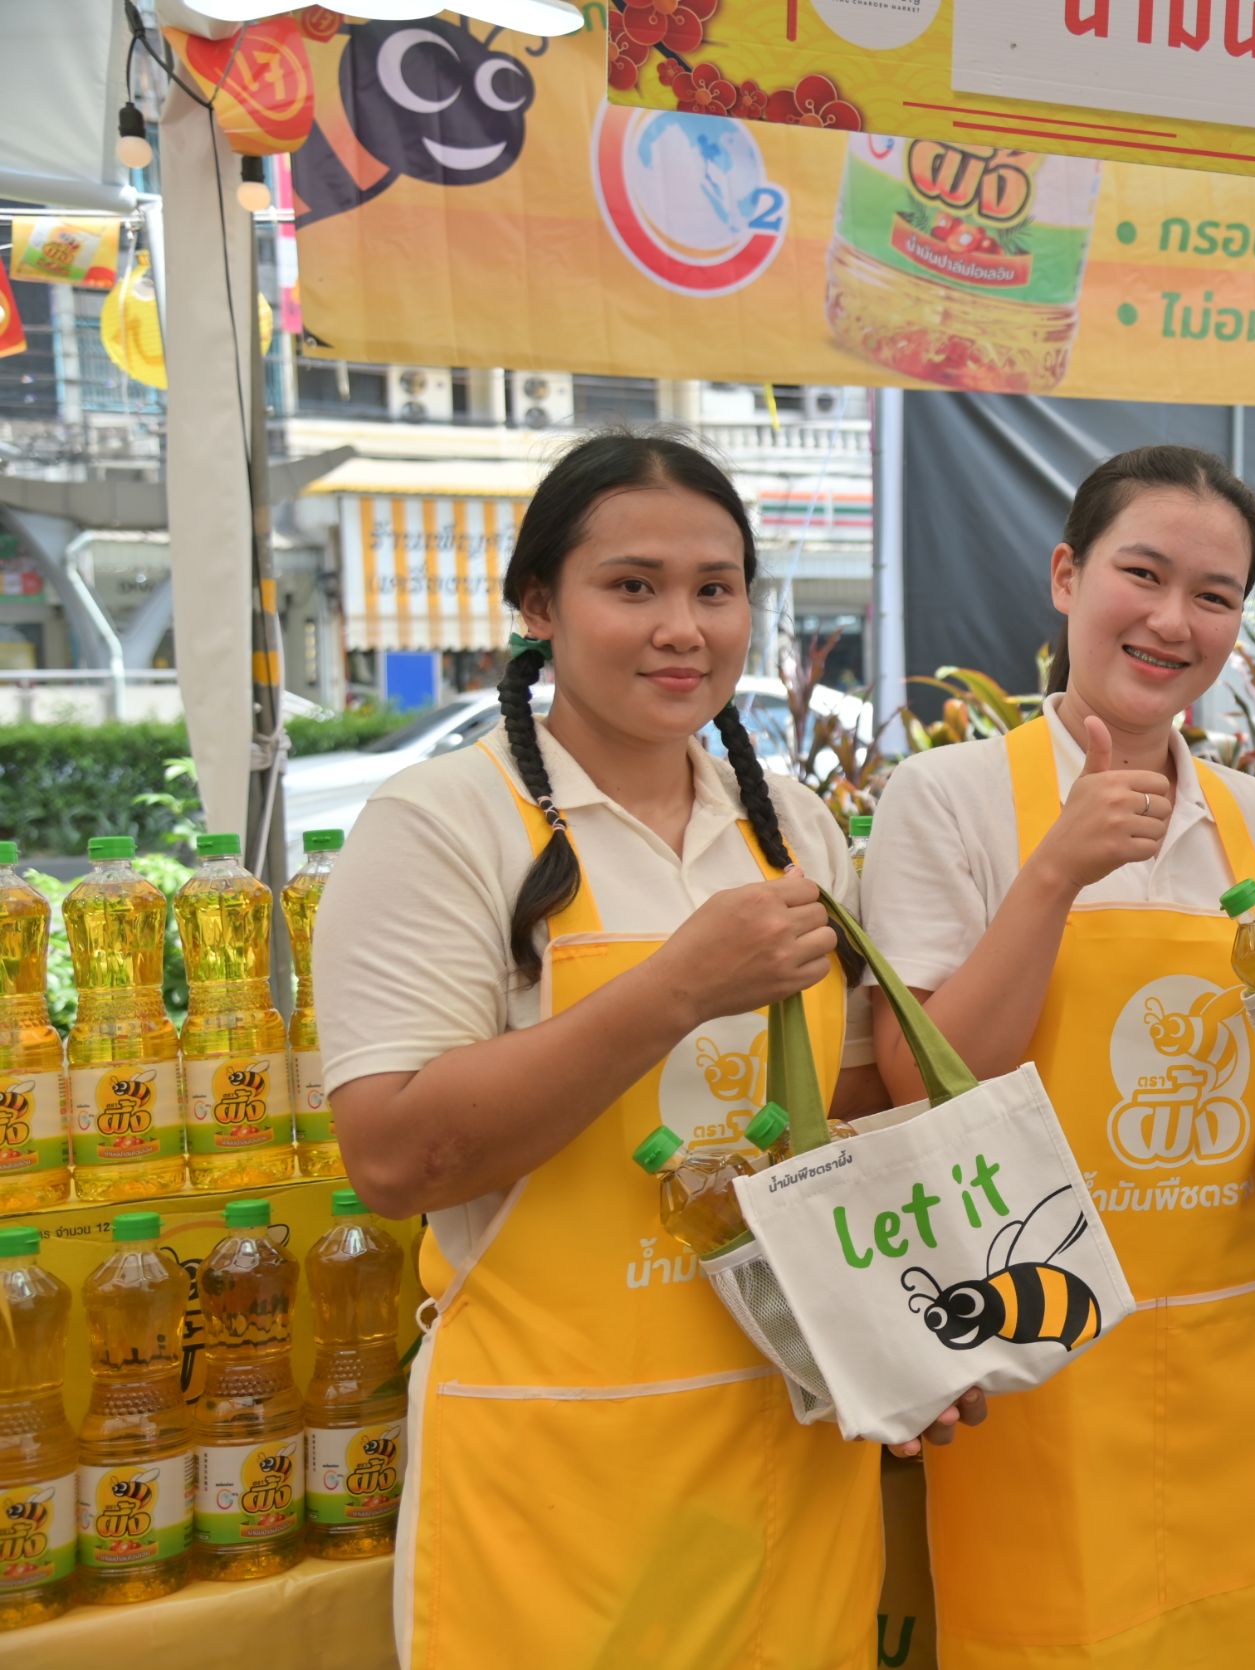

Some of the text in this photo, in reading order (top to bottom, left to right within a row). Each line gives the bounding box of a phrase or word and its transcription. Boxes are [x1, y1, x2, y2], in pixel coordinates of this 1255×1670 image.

[1137, 1076, 1166, 1088] ตรา
[693, 1123, 727, 1139] ตรา
[1109, 1065, 1248, 1167] ผึ้ง
[768, 1151, 853, 1194] น้ำมันพืชตราผึ้ง
[951, 1154, 1010, 1229] it
[56, 1224, 91, 1239] จำนวน
[96, 1222, 111, 1233] 12
